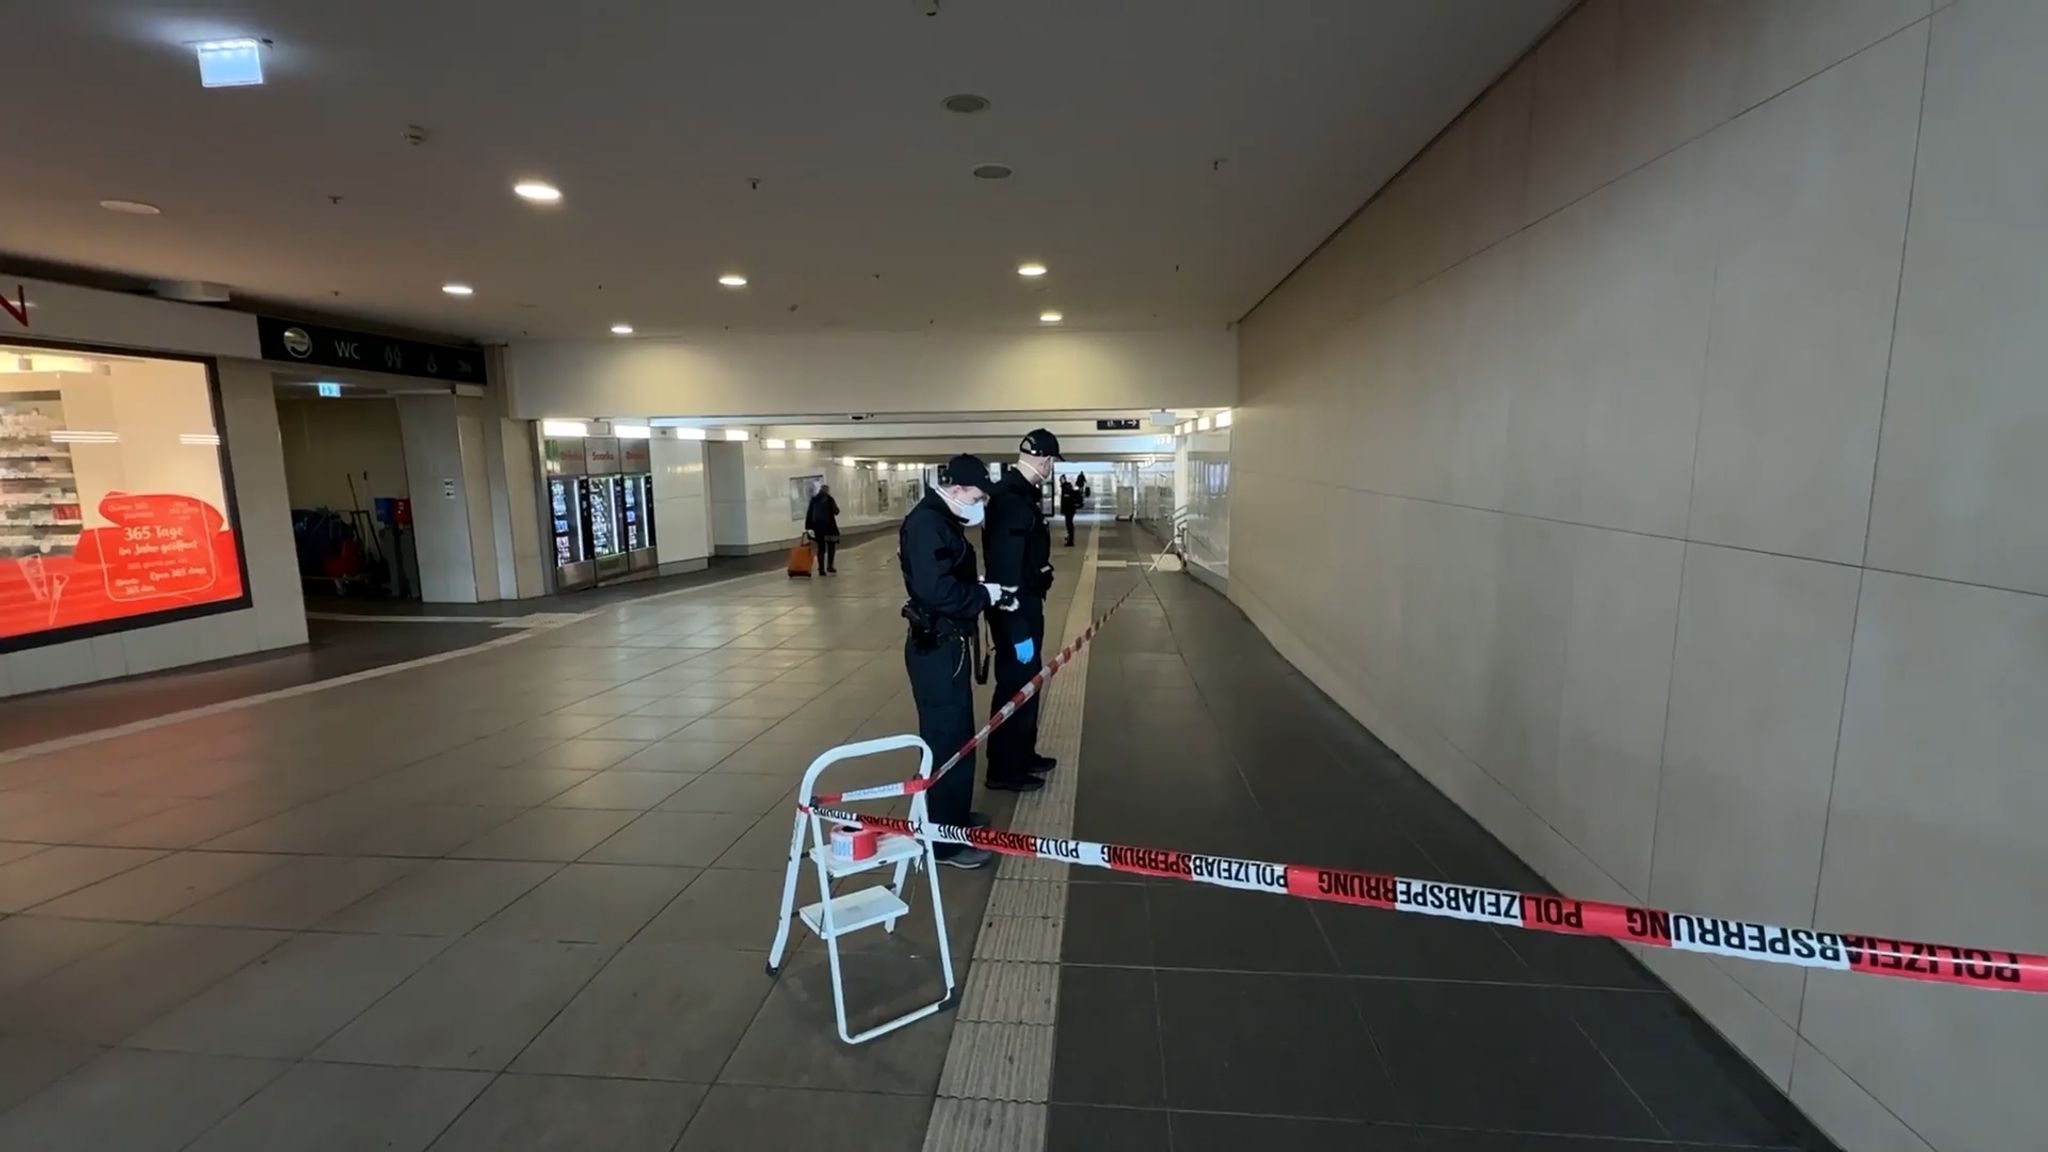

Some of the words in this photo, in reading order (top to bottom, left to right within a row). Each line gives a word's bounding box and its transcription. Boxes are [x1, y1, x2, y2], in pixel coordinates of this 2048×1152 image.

[335, 340, 360, 360] WC
[124, 526, 151, 541] 365
[153, 525, 184, 540] Tage
[134, 543, 159, 556] Jahr
[938, 824, 1080, 859] POLIZEIABSPERRUNG
[1101, 844, 1288, 888] POLIZEIABSPERRUNG
[1318, 870, 1583, 928] POLIZEIABSPERRUNG
[1627, 907, 2021, 982] POLIZEIABSPERRUNG
